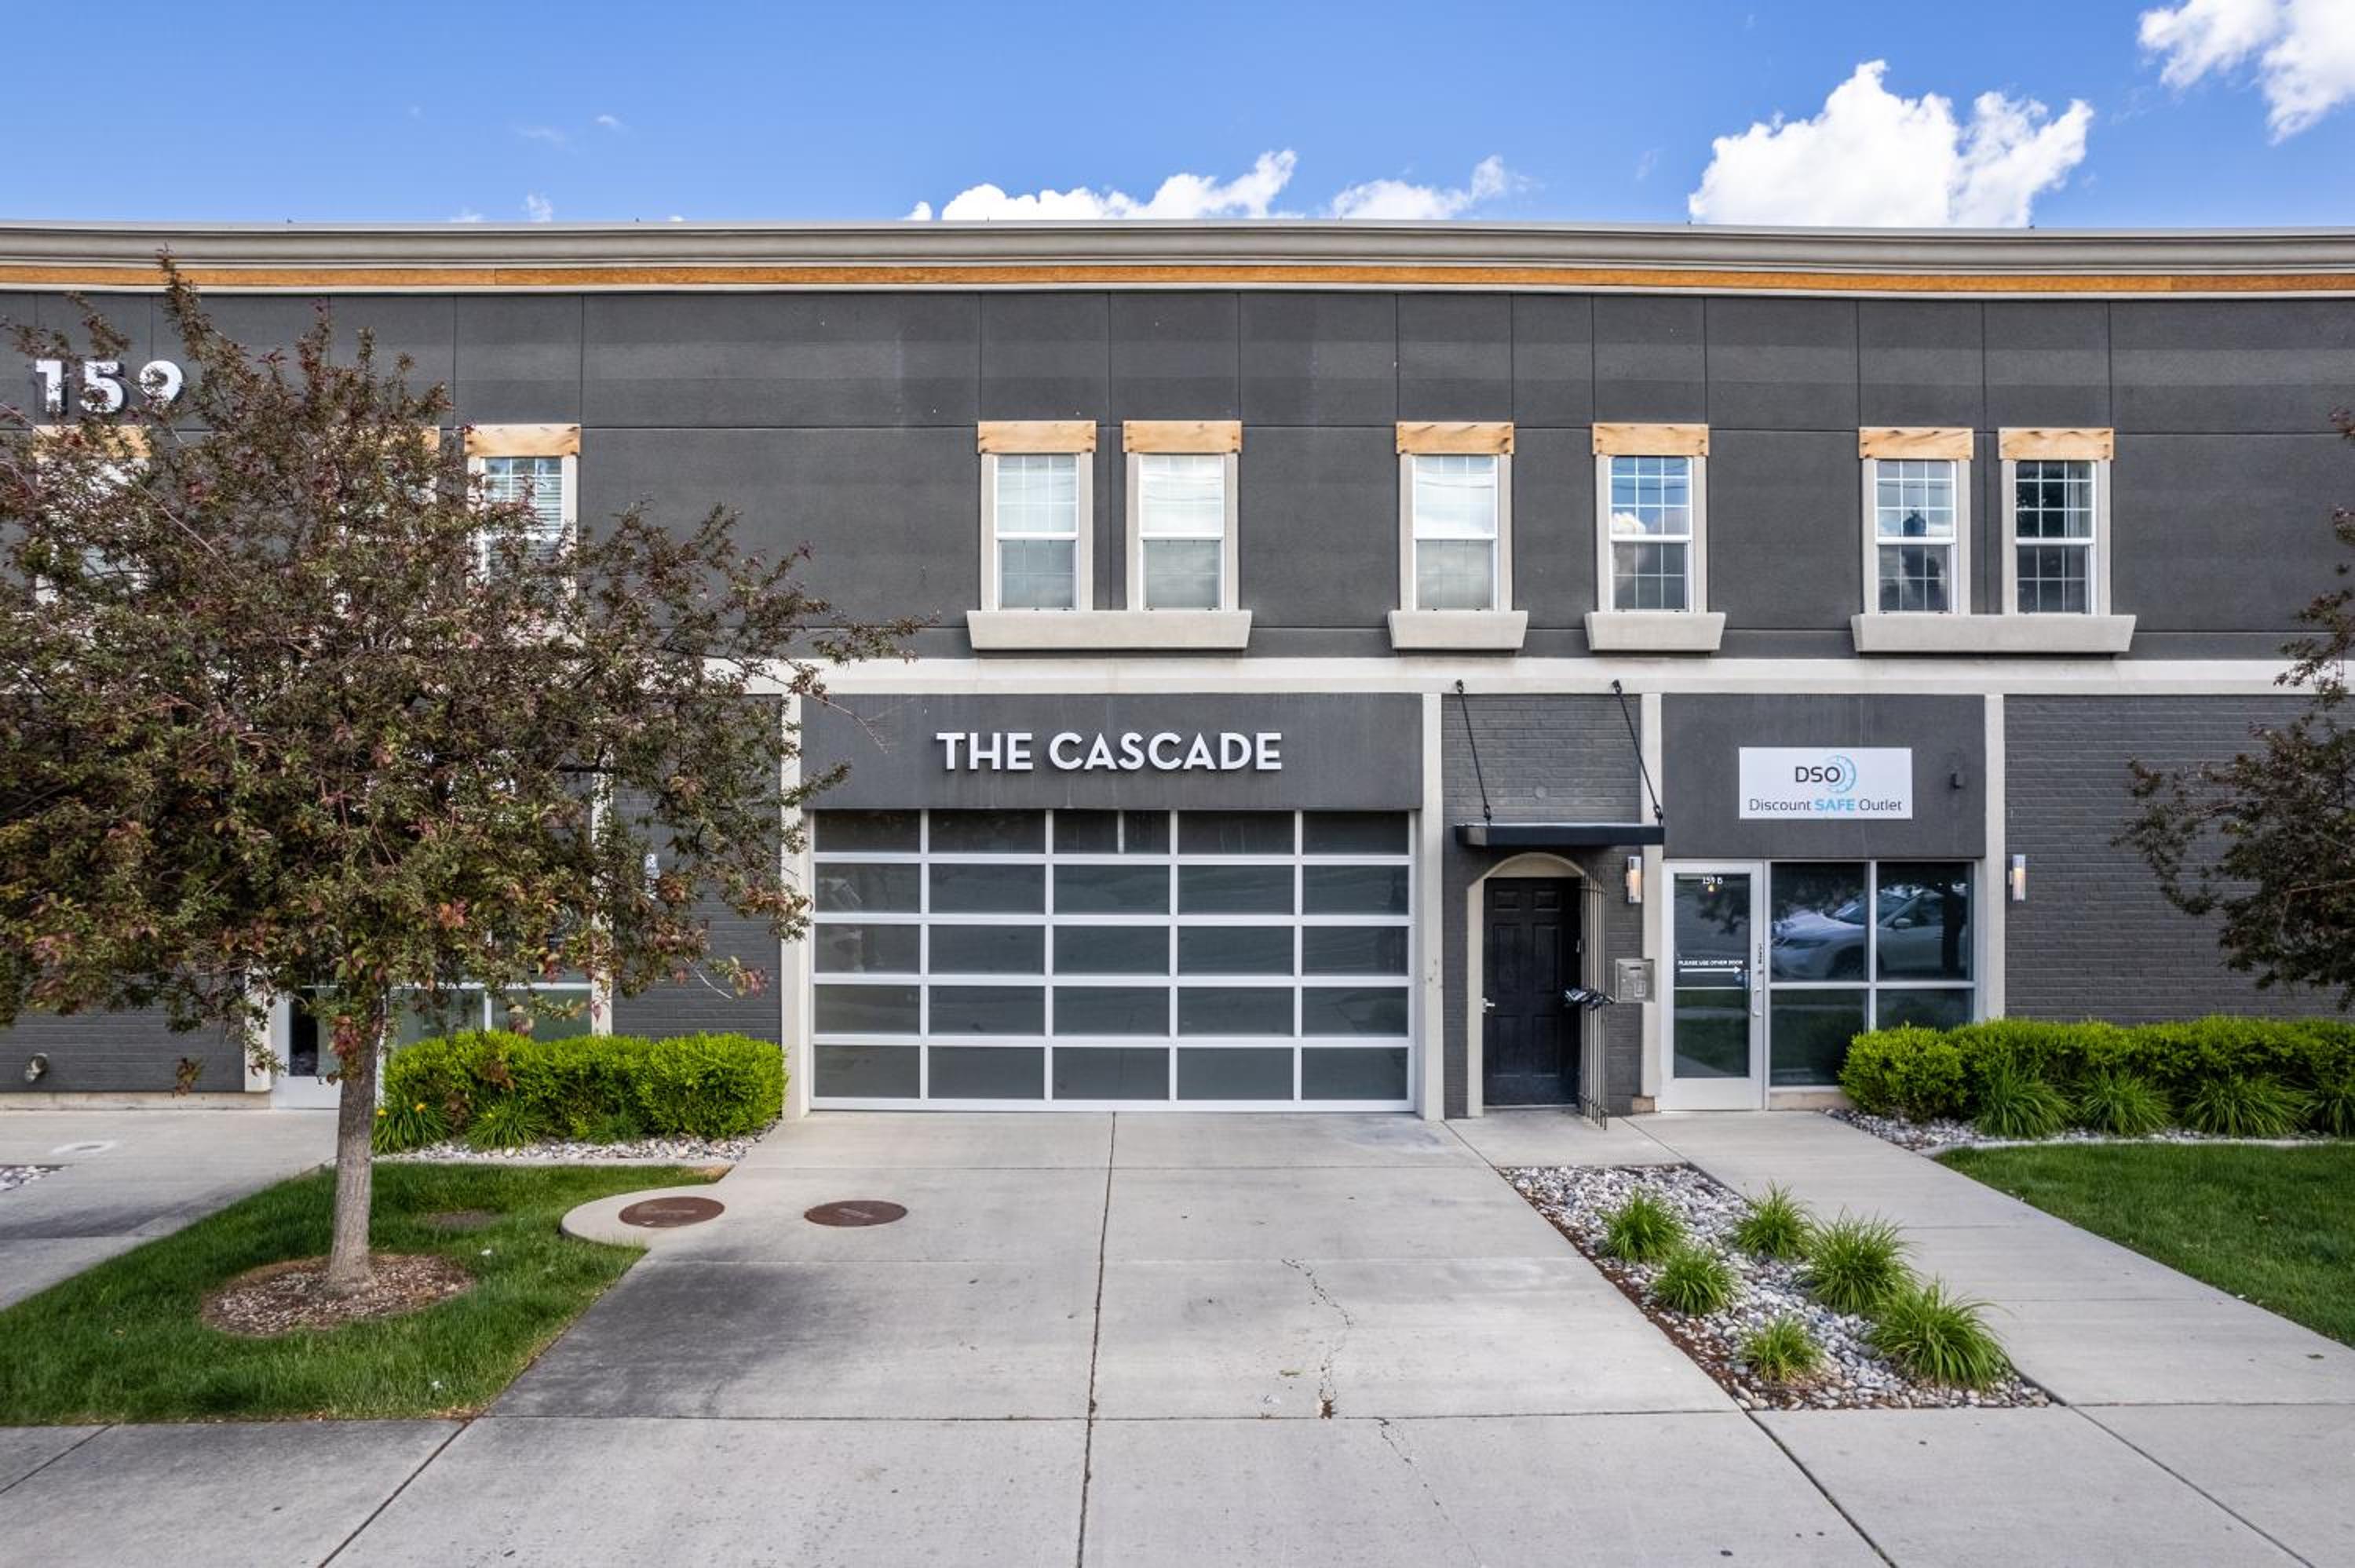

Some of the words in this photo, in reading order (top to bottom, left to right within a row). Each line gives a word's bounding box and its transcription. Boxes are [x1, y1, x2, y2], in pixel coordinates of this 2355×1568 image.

[35, 359, 184, 413] 159
[936, 732, 1033, 770] THE
[1049, 732, 1282, 771] CASCADE
[1795, 766, 1841, 782] DSO
[1749, 798, 1812, 811] Discount
[1814, 799, 1855, 811] SAFE
[1858, 798, 1902, 811] Outlet
